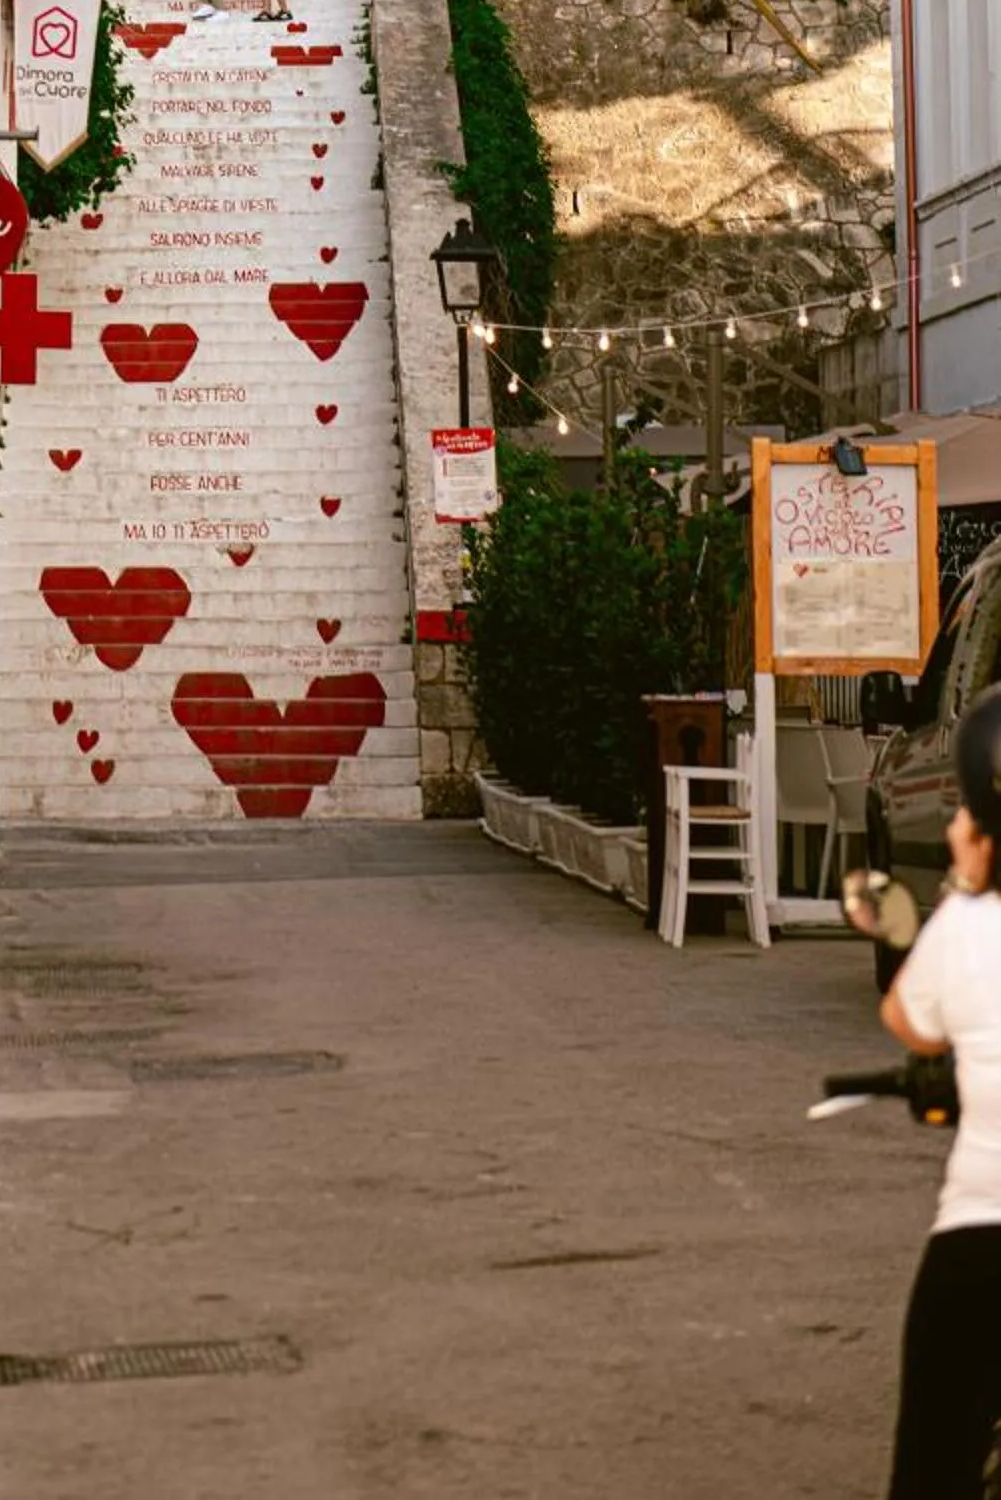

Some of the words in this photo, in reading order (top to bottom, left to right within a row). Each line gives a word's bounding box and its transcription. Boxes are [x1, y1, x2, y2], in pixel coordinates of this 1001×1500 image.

[16, 64, 74, 83] Dimora
[34, 81, 88, 99] Cuore
[155, 387, 167, 402] TI
[148, 431, 175, 447] PER
[180, 430, 250, 447] CENT'ANNI
[151, 474, 192, 491] FOSSE
[198, 474, 243, 492] ANCHE
[123, 523, 147, 540] MA
[152, 523, 167, 540] IO
[173, 524, 185, 540] TI
